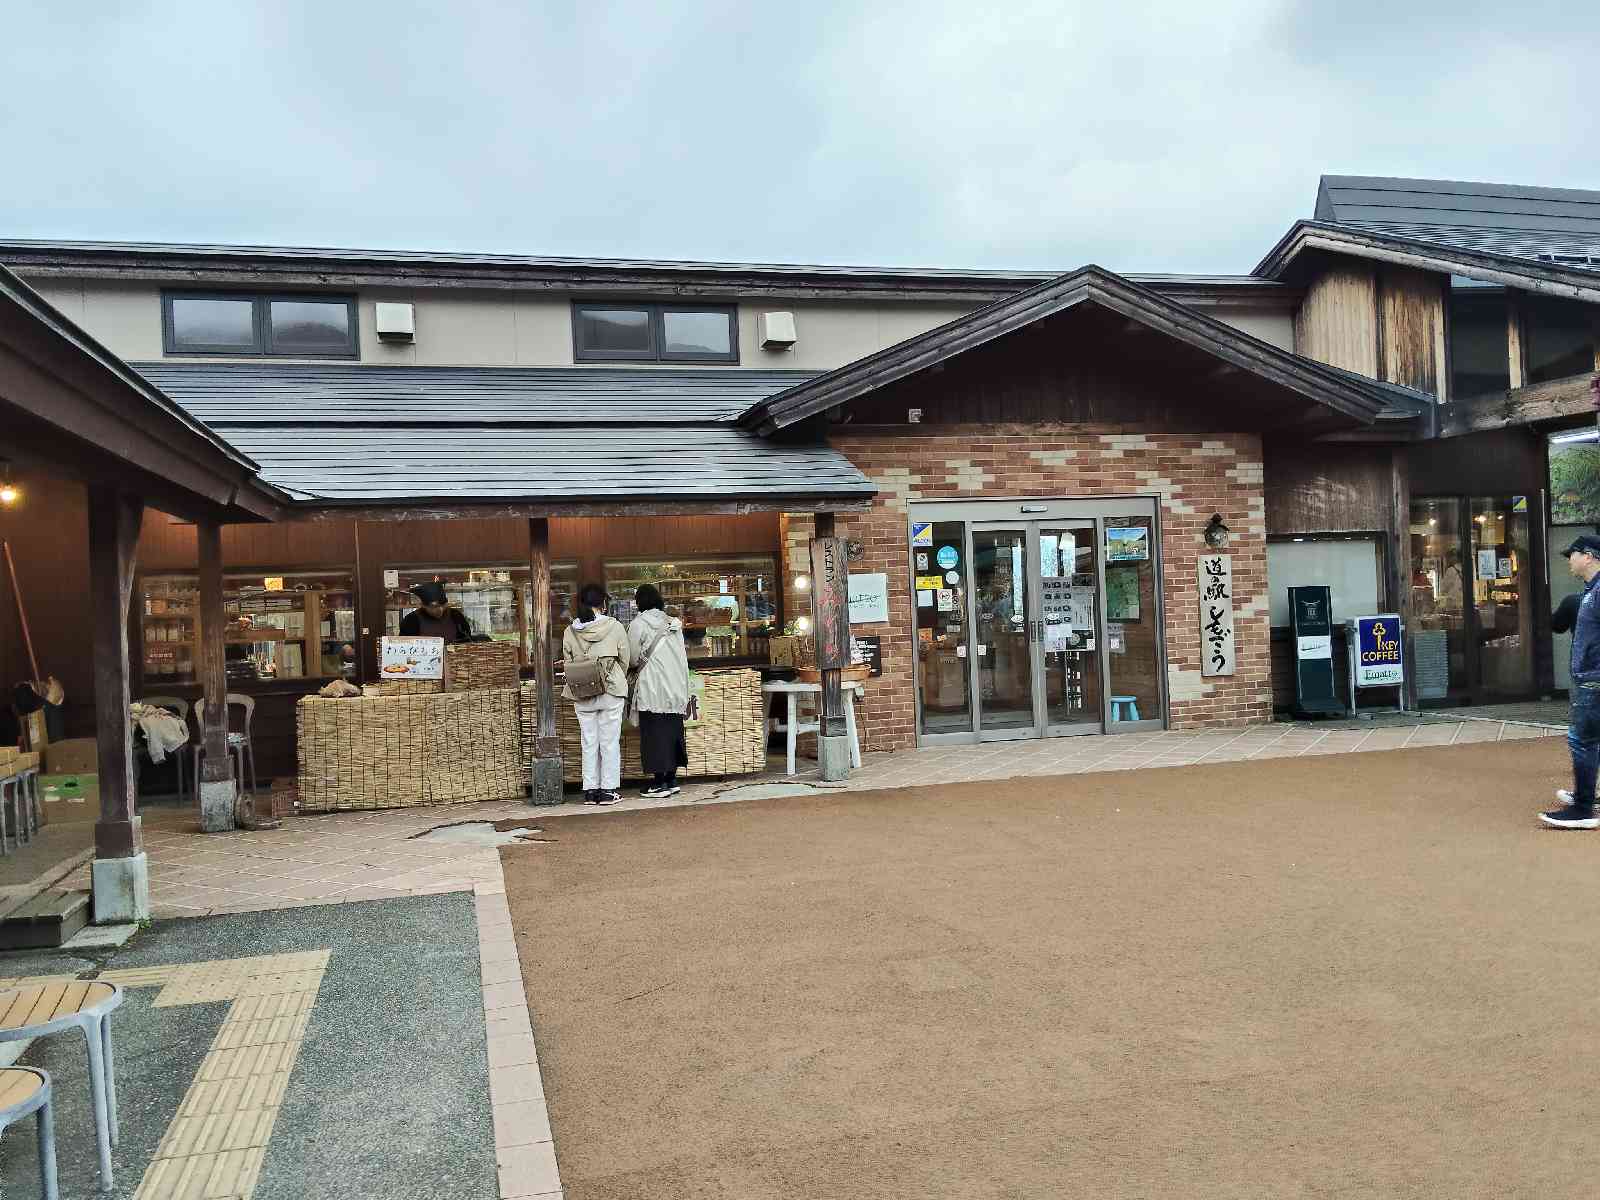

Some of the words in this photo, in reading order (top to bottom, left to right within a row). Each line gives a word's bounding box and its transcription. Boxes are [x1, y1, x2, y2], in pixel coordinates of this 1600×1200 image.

[1203, 556, 1230, 601] 道の駅
[1381, 640, 1399, 650] KEY
[1362, 650, 1399, 662] COFFEE
